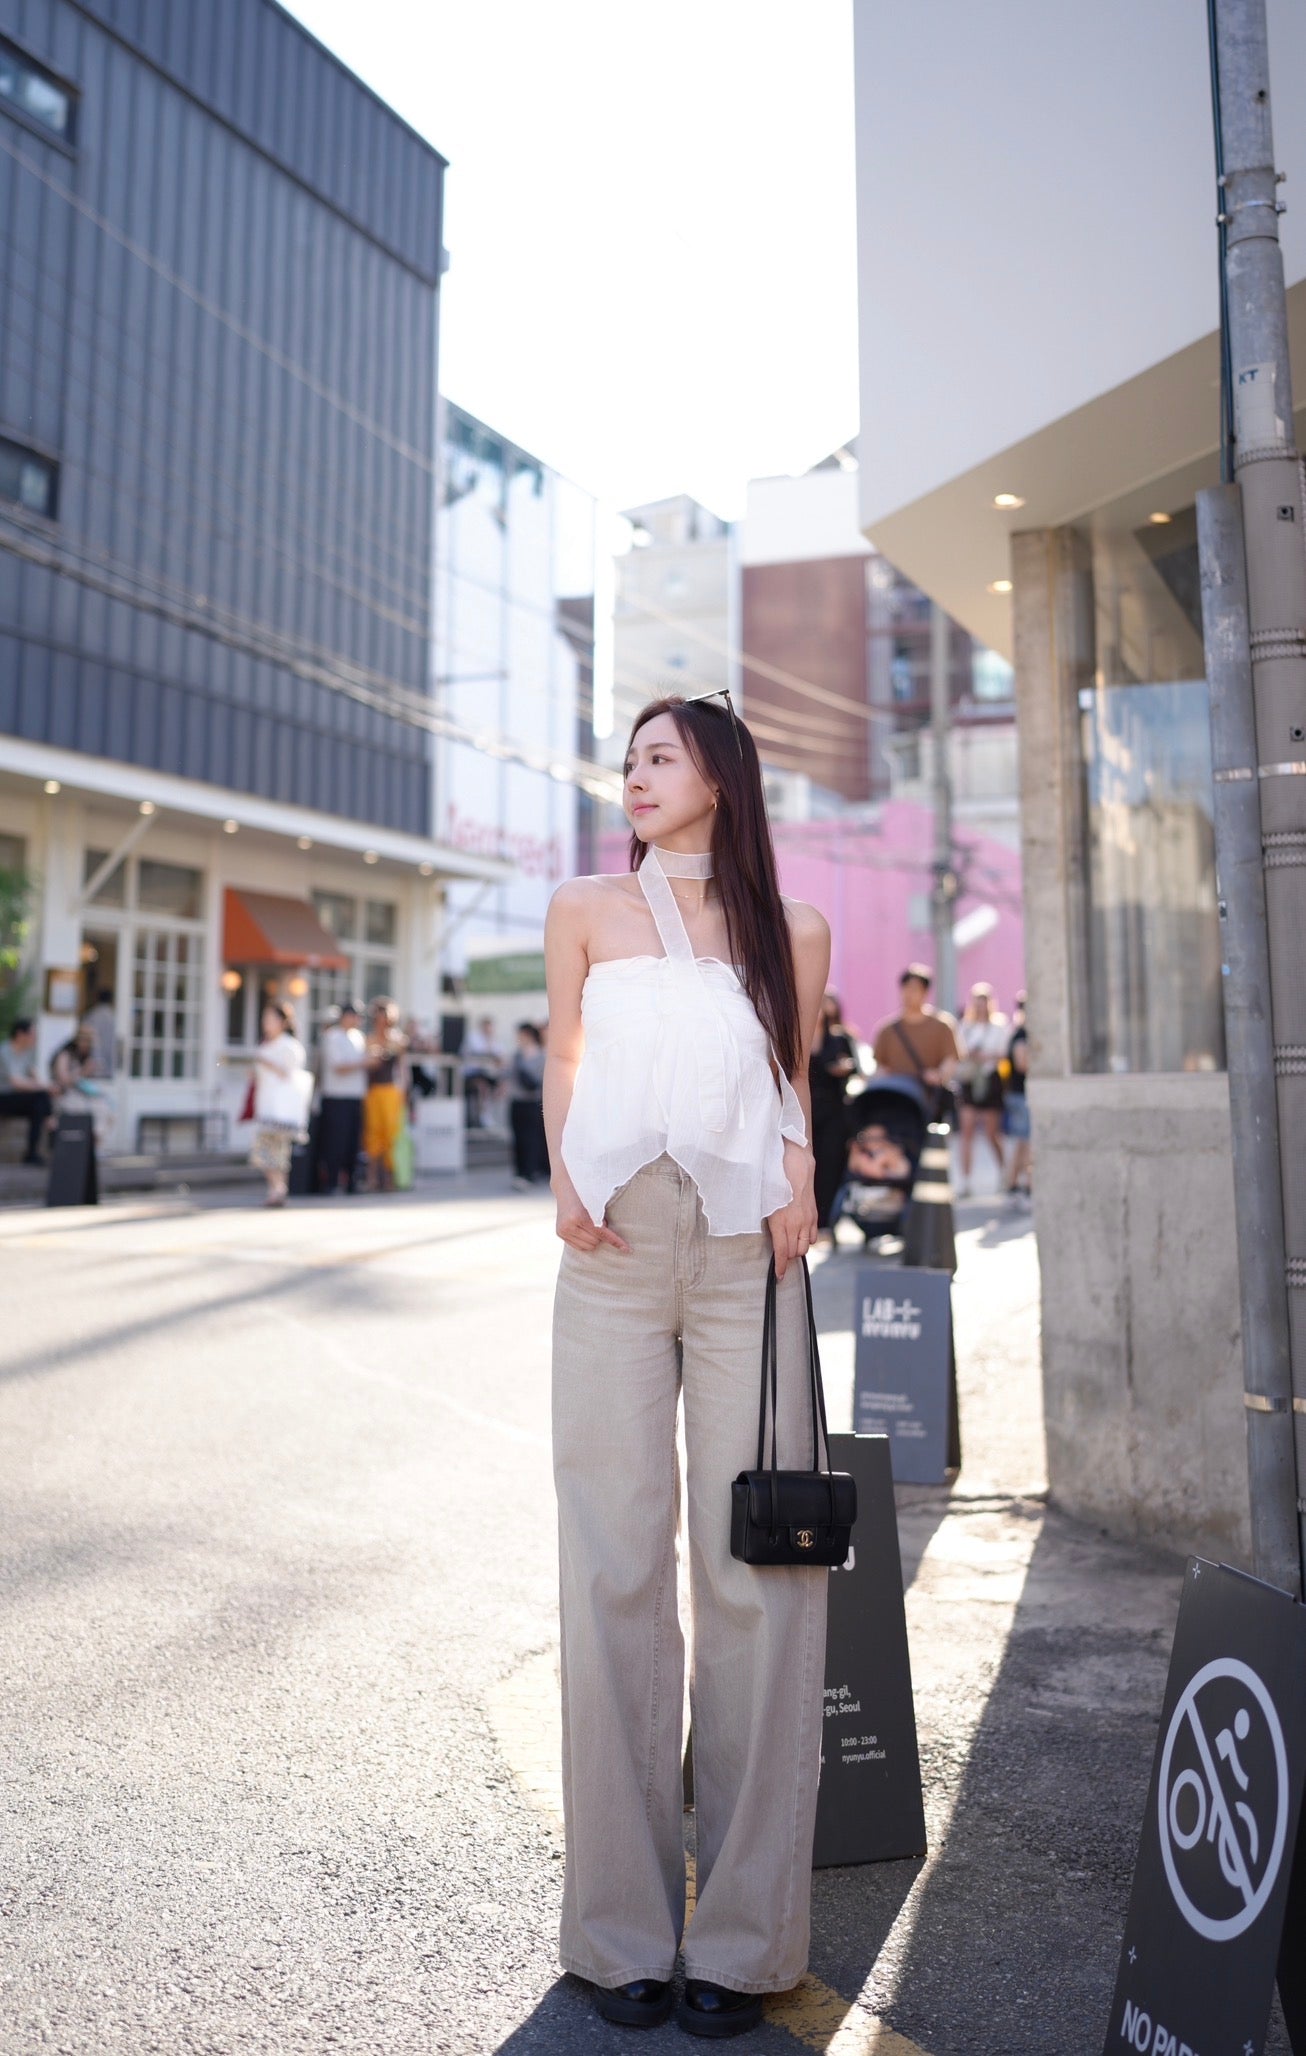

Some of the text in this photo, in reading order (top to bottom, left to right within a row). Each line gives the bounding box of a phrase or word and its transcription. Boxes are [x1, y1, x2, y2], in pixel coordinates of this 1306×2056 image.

[1239, 369, 1259, 386] KT
[823, 1685, 851, 1699] ang-gil,
[839, 1700, 861, 1713] Seoul
[841, 1737, 857, 1747] 10:00
[861, 1735, 877, 1745] 23:00
[842, 1750, 886, 1764] nyunyu.official
[1121, 1999, 1152, 2052] NO
